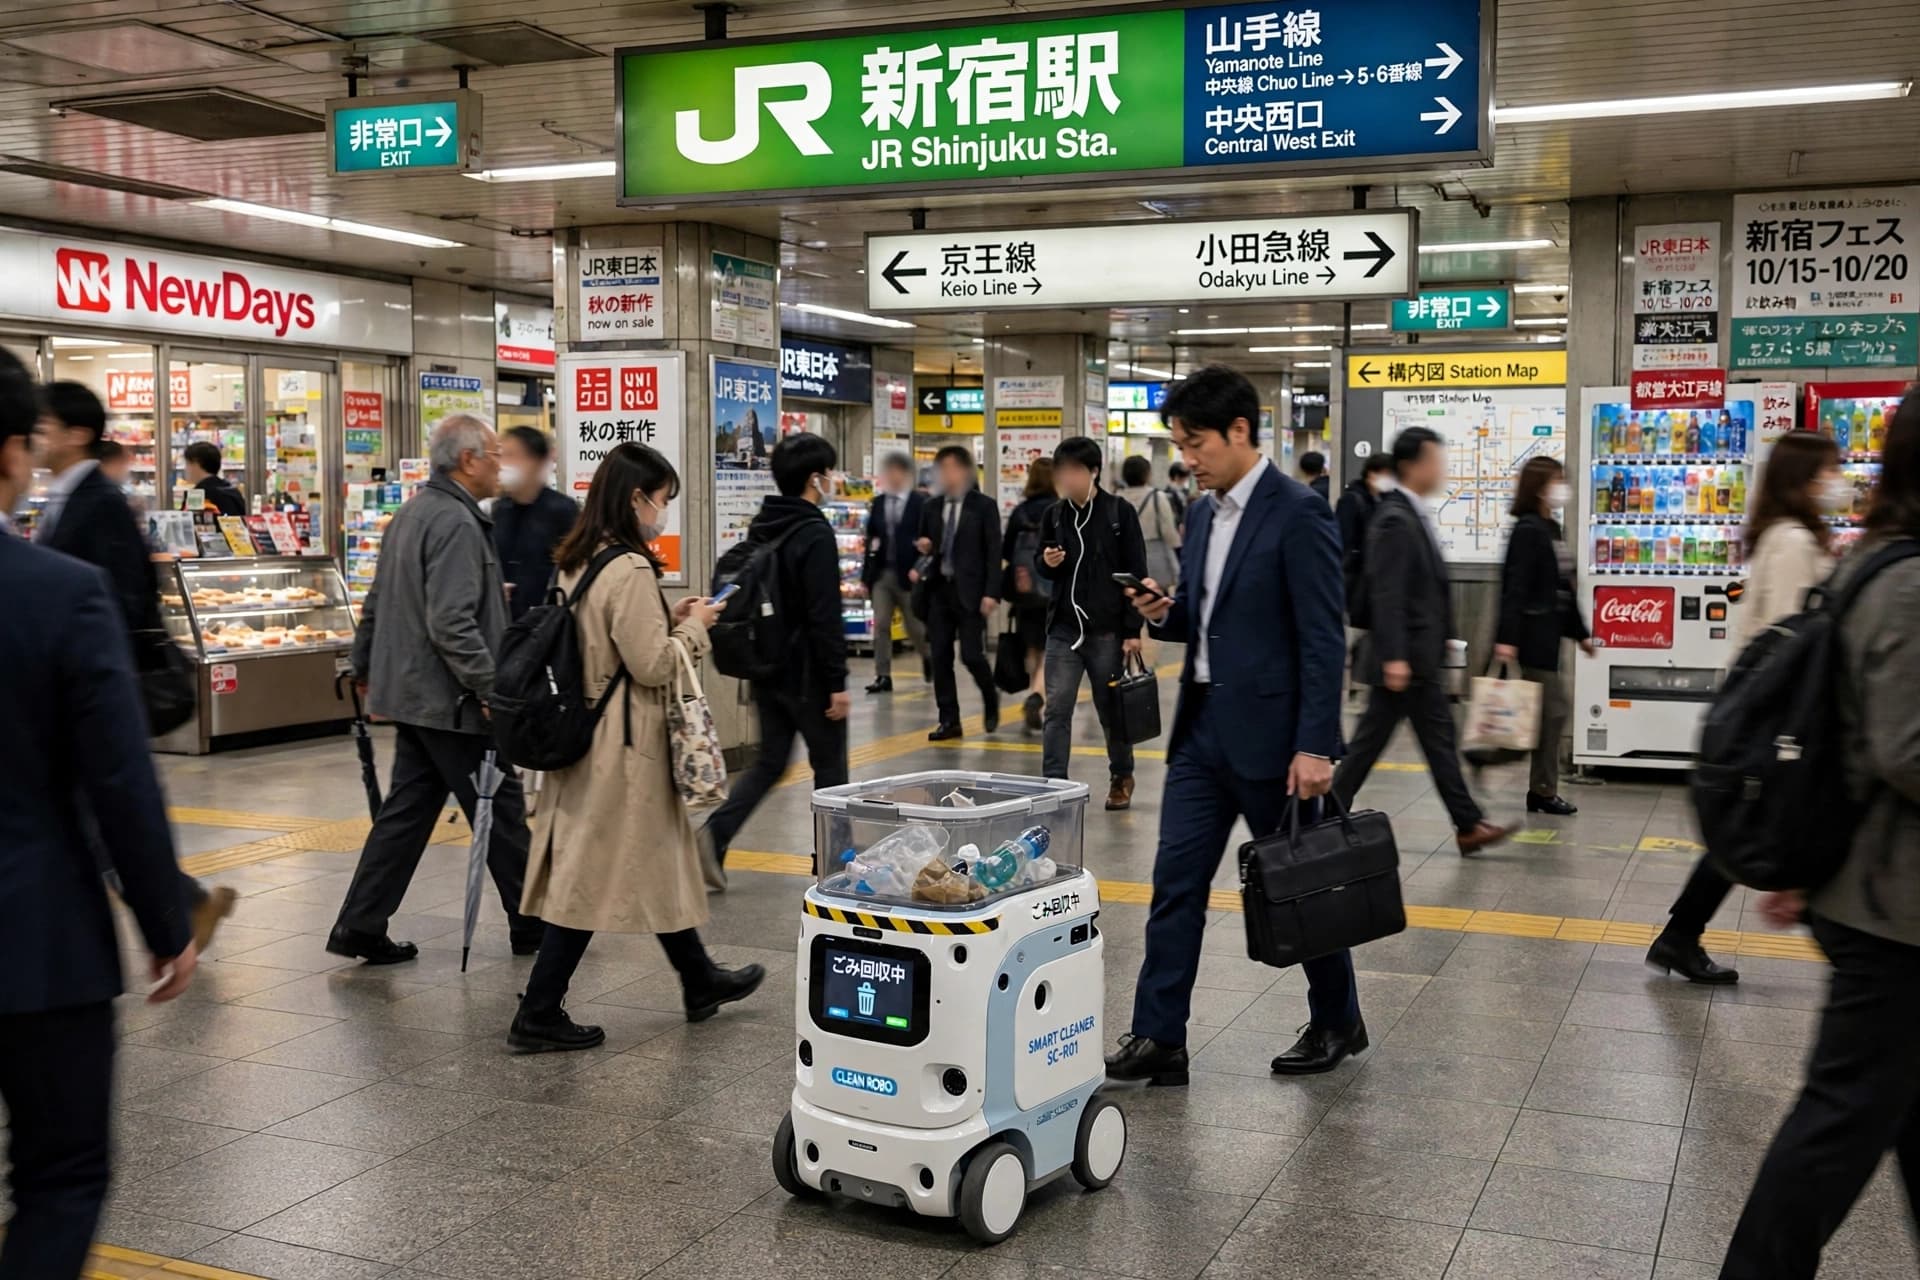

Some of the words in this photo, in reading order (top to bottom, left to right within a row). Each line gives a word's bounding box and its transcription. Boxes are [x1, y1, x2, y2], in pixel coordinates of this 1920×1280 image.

[1206, 9, 1322, 55] 山手線
[1205, 54, 1284, 74] Yamanote
[1289, 51, 1323, 68] Line
[860, 30, 1121, 131] 新宿駅
[1205, 78, 1254, 96] 中央線
[1257, 75, 1298, 92] Chuo
[1302, 72, 1335, 88] Line
[675, 61, 834, 165] JR
[1205, 100, 1323, 135] 中央西口
[350, 118, 421, 151] 非常口
[1205, 134, 1268, 155] Central
[1274, 132, 1317, 150] West
[1322, 129, 1356, 148] Exit
[381, 151, 412, 167] EXIT
[861, 139, 902, 170] JR
[911, 131, 1046, 171] Shinjuku
[1056, 127, 1117, 159] Sta.
[1640, 237, 1710, 256] JR東日本
[1746, 217, 1905, 252] 新宿フェス
[940, 241, 1036, 276] 京王線
[1196, 228, 1330, 266] 小田急線
[582, 255, 657, 276] JR東日本
[1746, 253, 1908, 285] 10/15-10/20
[941, 280, 977, 297] Keio
[983, 279, 1017, 295] Line
[1199, 269, 1266, 291] Odakyu
[1272, 268, 1309, 285] Line
[1643, 278, 1712, 296] 新宿フェス
[125, 258, 315, 337] NewDays
[588, 293, 653, 314] 秋の新作
[1407, 296, 1471, 318] 非常口
[588, 320, 611, 330] now
[615, 319, 628, 328] on
[632, 316, 654, 328] sale
[1436, 317, 1463, 329] EXIT
[624, 372, 651, 387] UNI
[1388, 362, 1445, 383] 構内図
[1450, 364, 1501, 379] Station
[1507, 363, 1538, 380] Map
[624, 390, 654, 408] QLO
[716, 376, 772, 405] JR東日本
[579, 418, 657, 443] 秋の新作
[579, 448, 607, 461] now
[832, 955, 905, 985] ごみ回収中
[1028, 1030, 1058, 1054] SMART
[1060, 1015, 1095, 1041] CLEANER
[1047, 1041, 1079, 1066] SC-R01
[836, 1069, 865, 1087] CLEAN
[867, 1077, 893, 1093] ROBO
